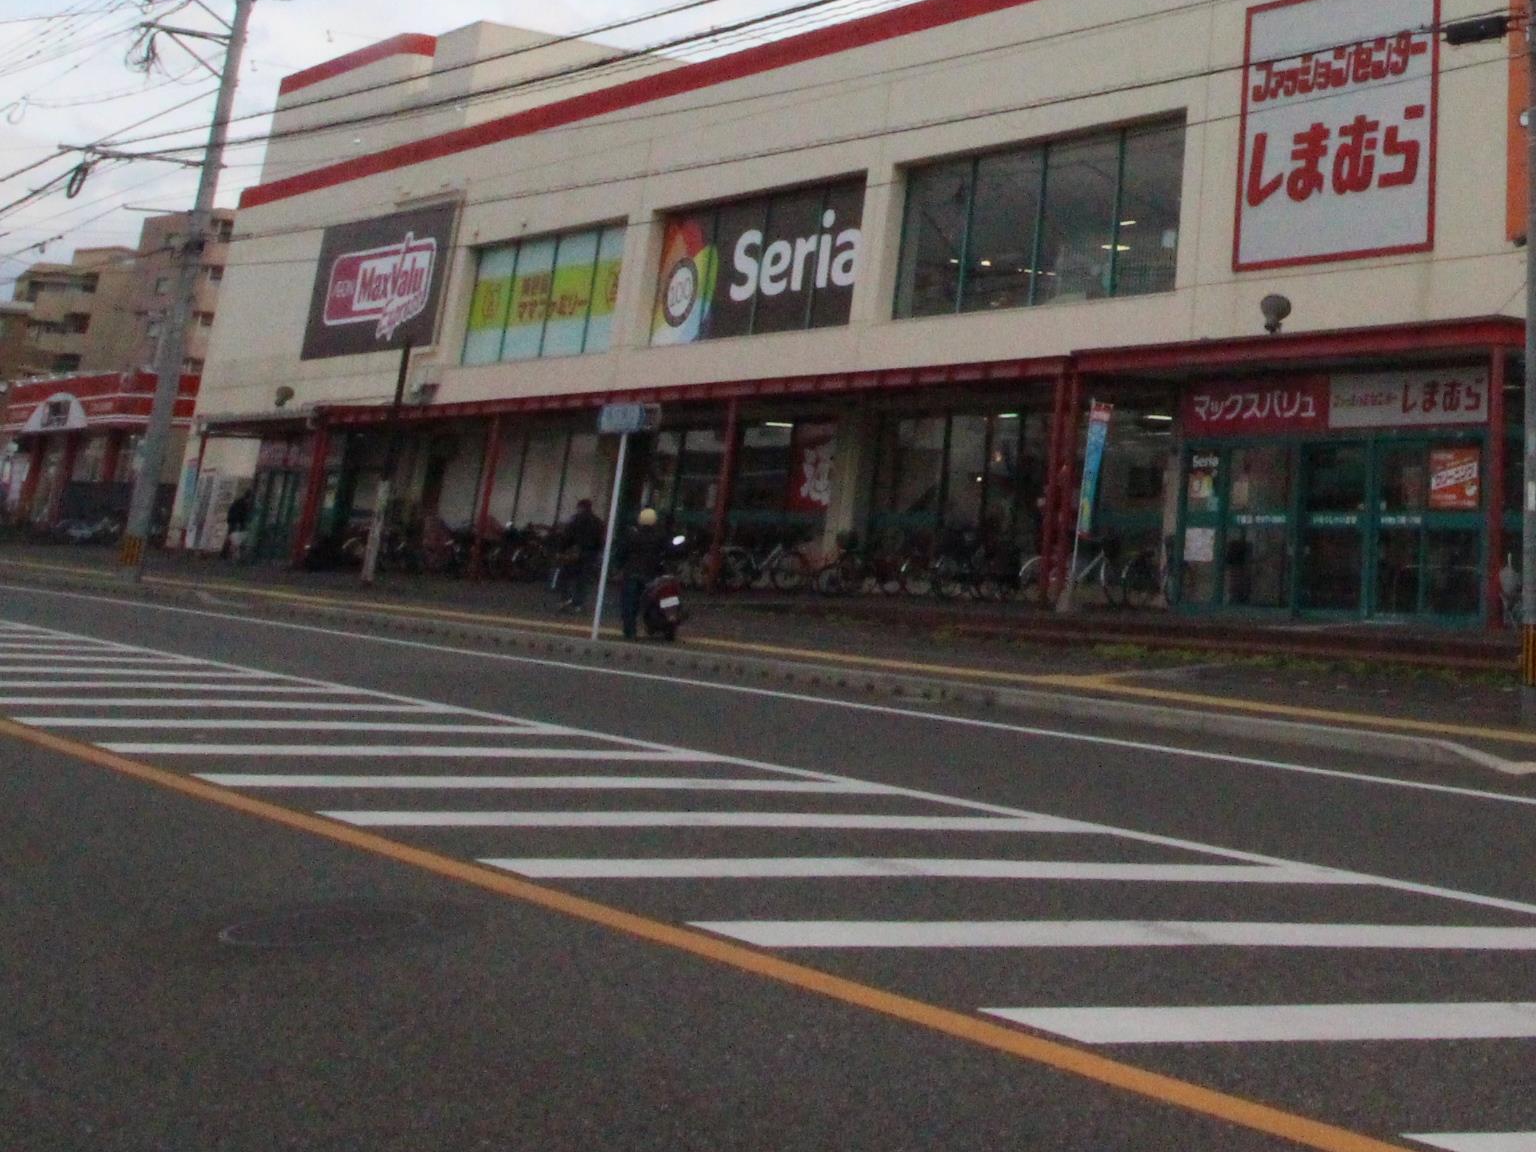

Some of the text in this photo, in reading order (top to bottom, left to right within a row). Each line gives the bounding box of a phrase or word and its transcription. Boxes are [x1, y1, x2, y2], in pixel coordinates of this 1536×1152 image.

[1252, 30, 1427, 102] ファッションセンター
[1248, 104, 1425, 207] しまむら
[730, 209, 863, 302] Seria
[1402, 377, 1484, 414] しまむら
